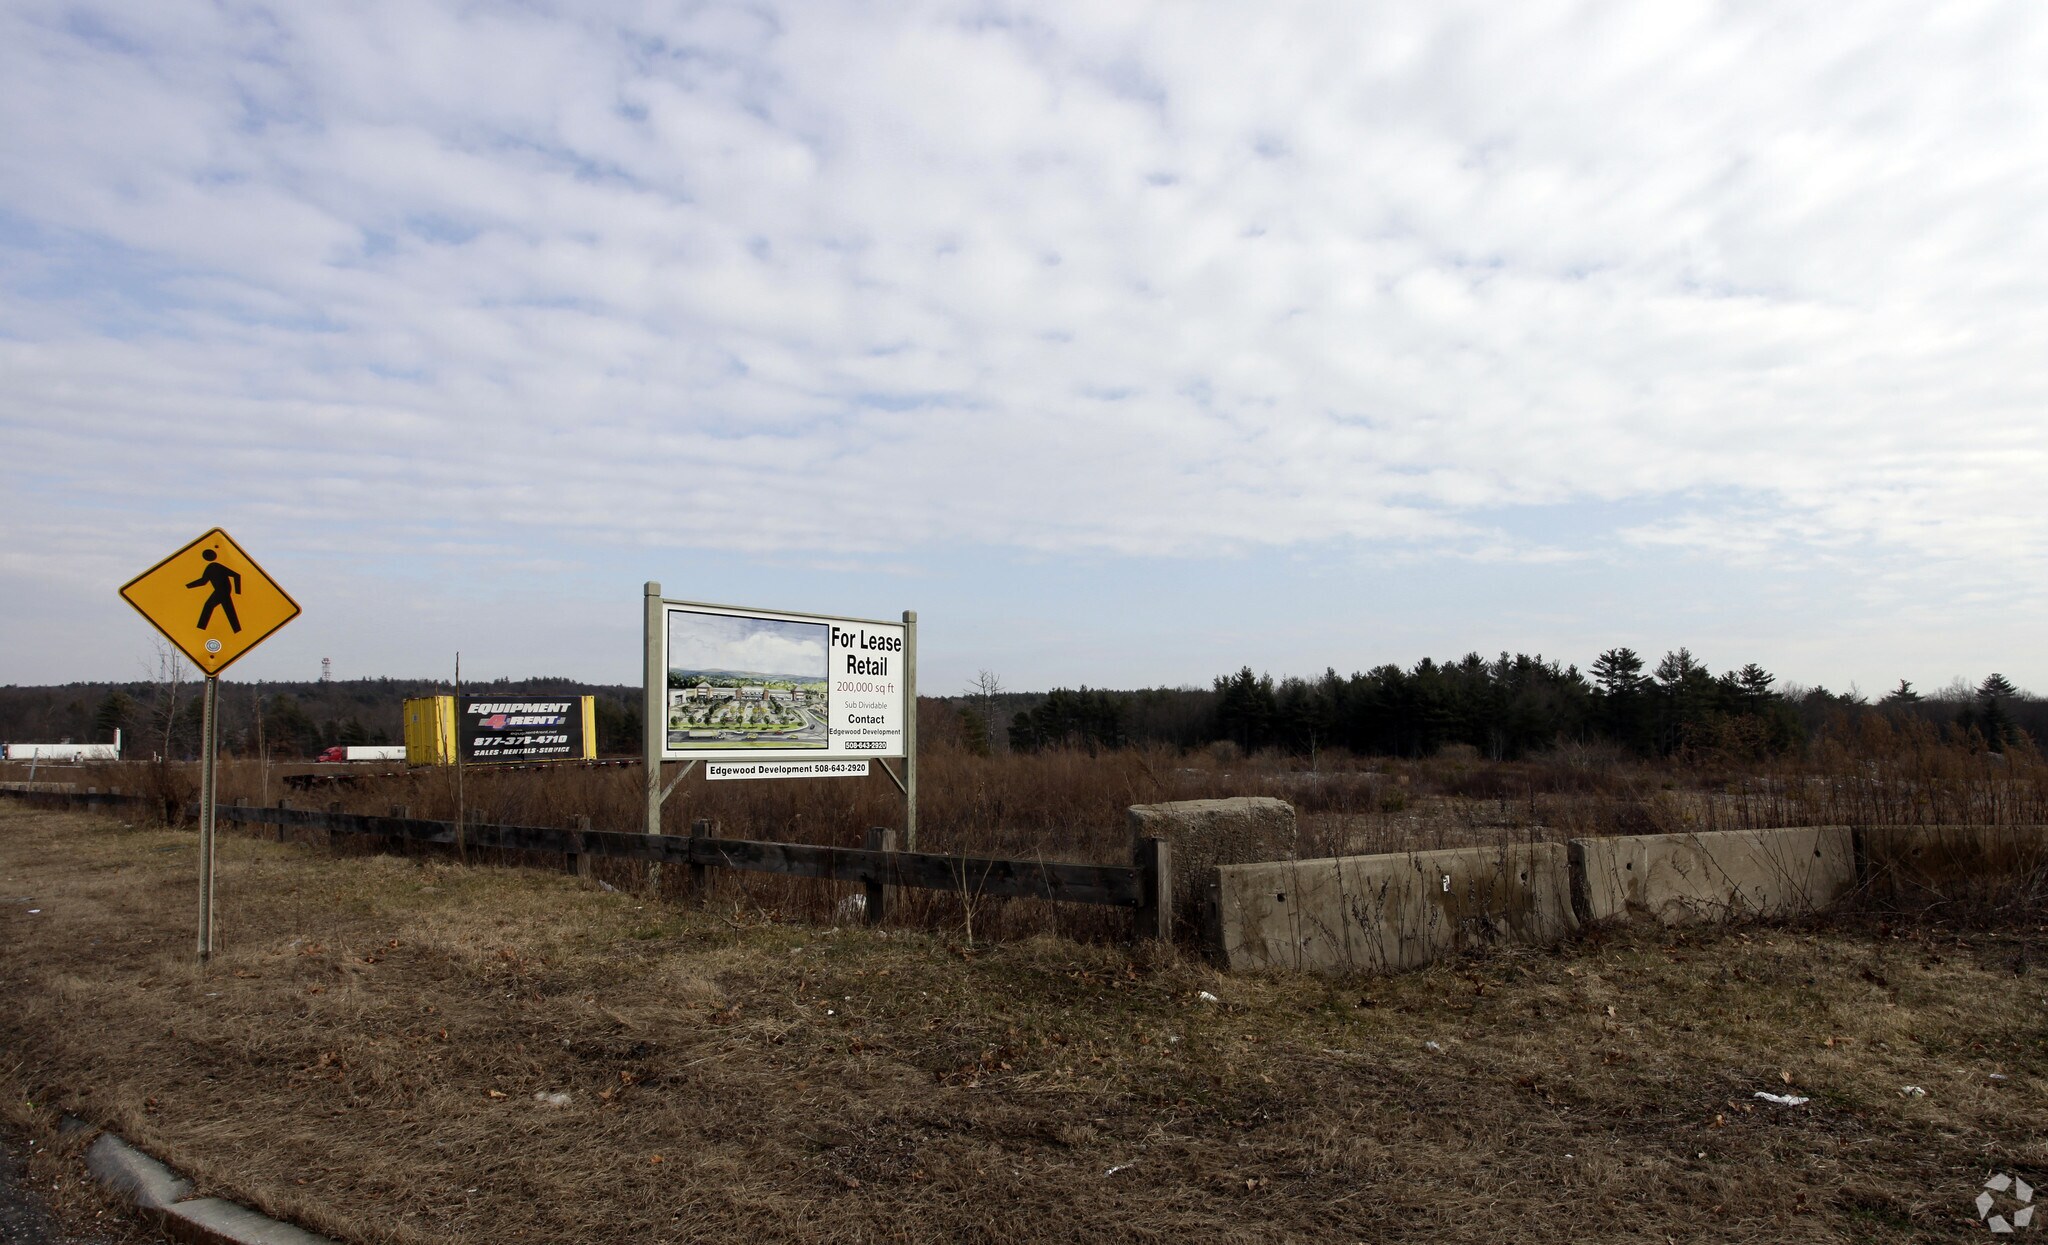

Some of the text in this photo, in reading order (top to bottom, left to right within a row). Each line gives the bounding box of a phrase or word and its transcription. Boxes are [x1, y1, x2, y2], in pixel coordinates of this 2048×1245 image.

[832, 627, 901, 652] For Lease
[847, 655, 887, 676] Retail
[837, 682, 894, 695] 200,000 sq ft
[467, 703, 571, 715] EQUIPMENT
[845, 701, 888, 709] Sub Dividable
[484, 714, 558, 729] 4 RENT
[848, 714, 885, 724] Contact
[829, 728, 901, 736] Edgewood Development
[710, 764, 866, 776] Edgewood Development 508-643-2920
